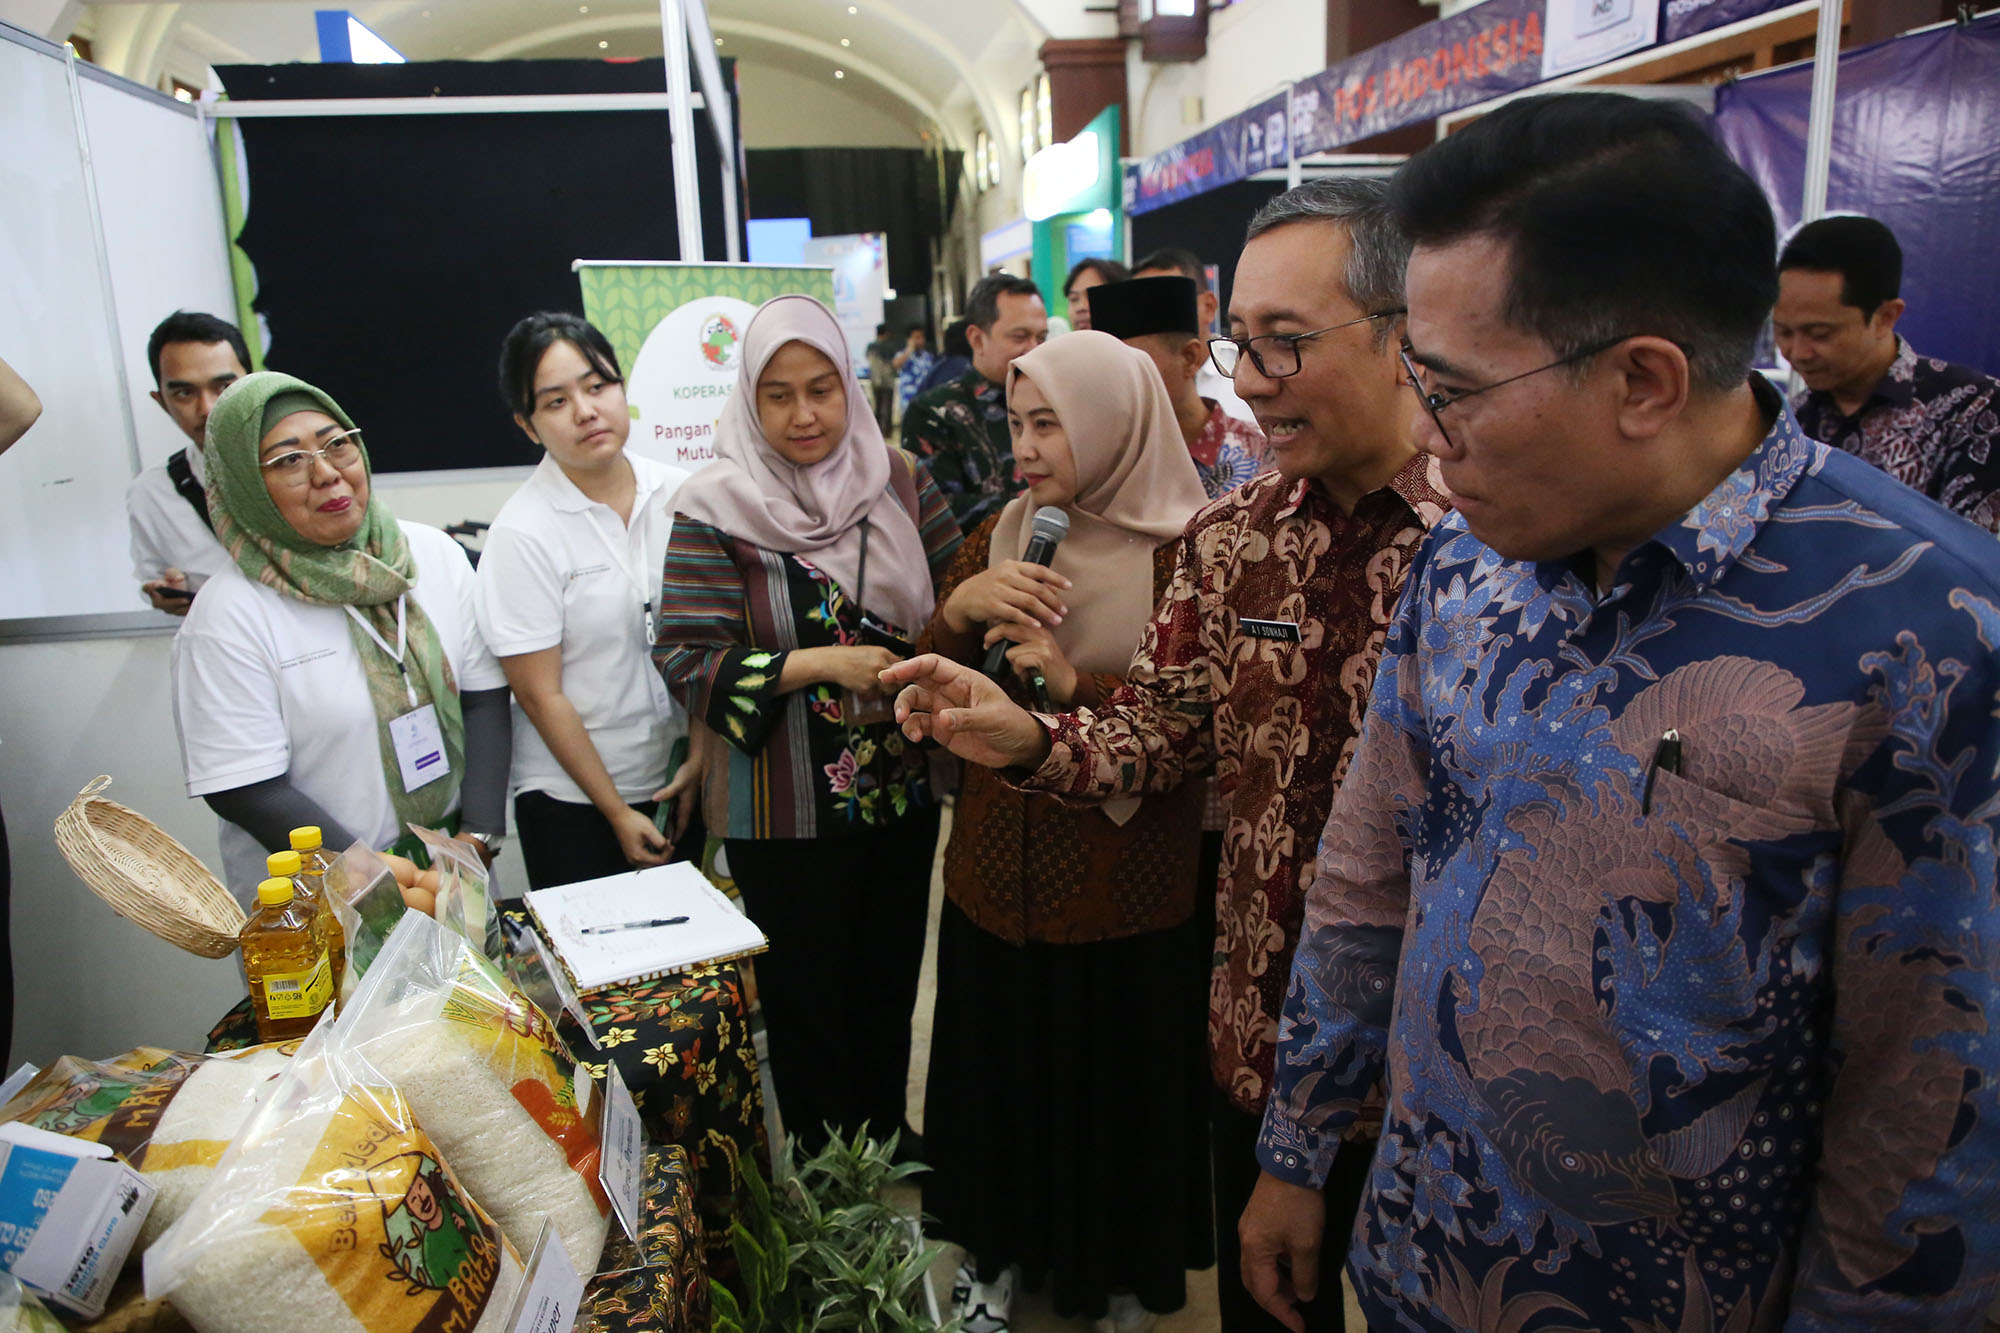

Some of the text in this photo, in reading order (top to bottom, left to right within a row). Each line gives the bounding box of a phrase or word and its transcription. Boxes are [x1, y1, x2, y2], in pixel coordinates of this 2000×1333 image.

[1333, 76, 1377, 125] POS
[1384, 11, 1544, 108] INDONESIA
[654, 424, 712, 440] Pangan
[676, 446, 714, 461] Mutu
[448, 1234, 486, 1304] BOLO
